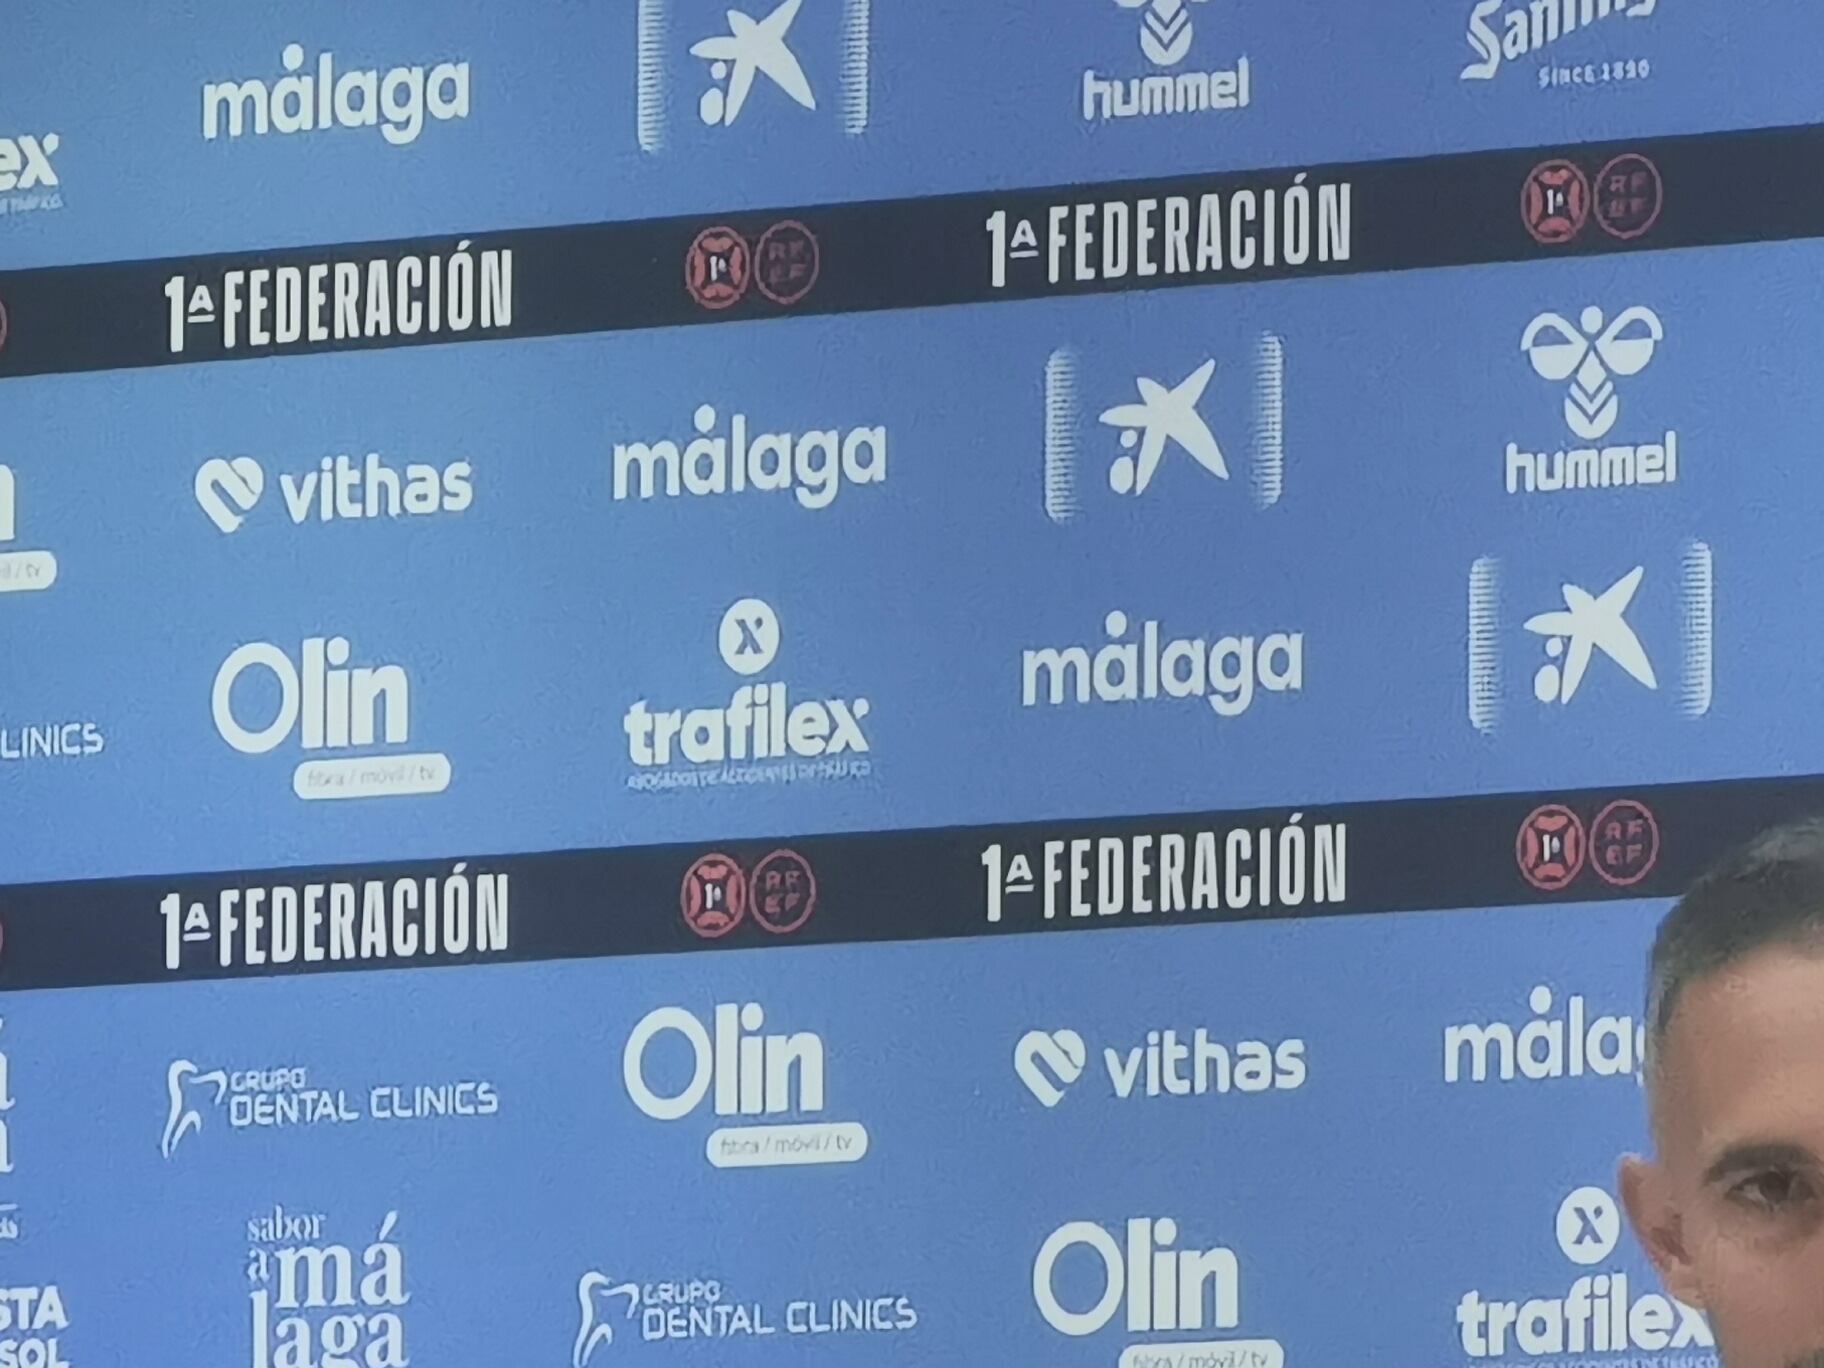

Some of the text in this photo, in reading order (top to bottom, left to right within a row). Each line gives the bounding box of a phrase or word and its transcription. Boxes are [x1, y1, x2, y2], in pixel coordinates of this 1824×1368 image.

[1083, 55, 1250, 121] hummel
[1048, 172, 1351, 284] FEDERACIÓN
[224, 239, 512, 349] FEDERACIÓN
[279, 453, 473, 524] vithas
[1506, 427, 1677, 494] hummel
[212, 636, 408, 754] Olin
[623, 681, 870, 766] trafilex
[0, 722, 104, 759] LINICS
[1044, 812, 1346, 919] FEDERACIÓN
[219, 862, 508, 967] FEDERACIÓN
[623, 1002, 824, 1120] Olin
[1103, 1028, 1306, 1098] vithas
[1443, 984, 1645, 1089] mála
[230, 1081, 498, 1126] DENTAL CLINICS
[247, 1205, 326, 1242] sabor
[642, 1278, 721, 1306] GRUPO
[1033, 1217, 1239, 1336] Olin
[642, 1295, 918, 1341] DENTAL CLINICS
